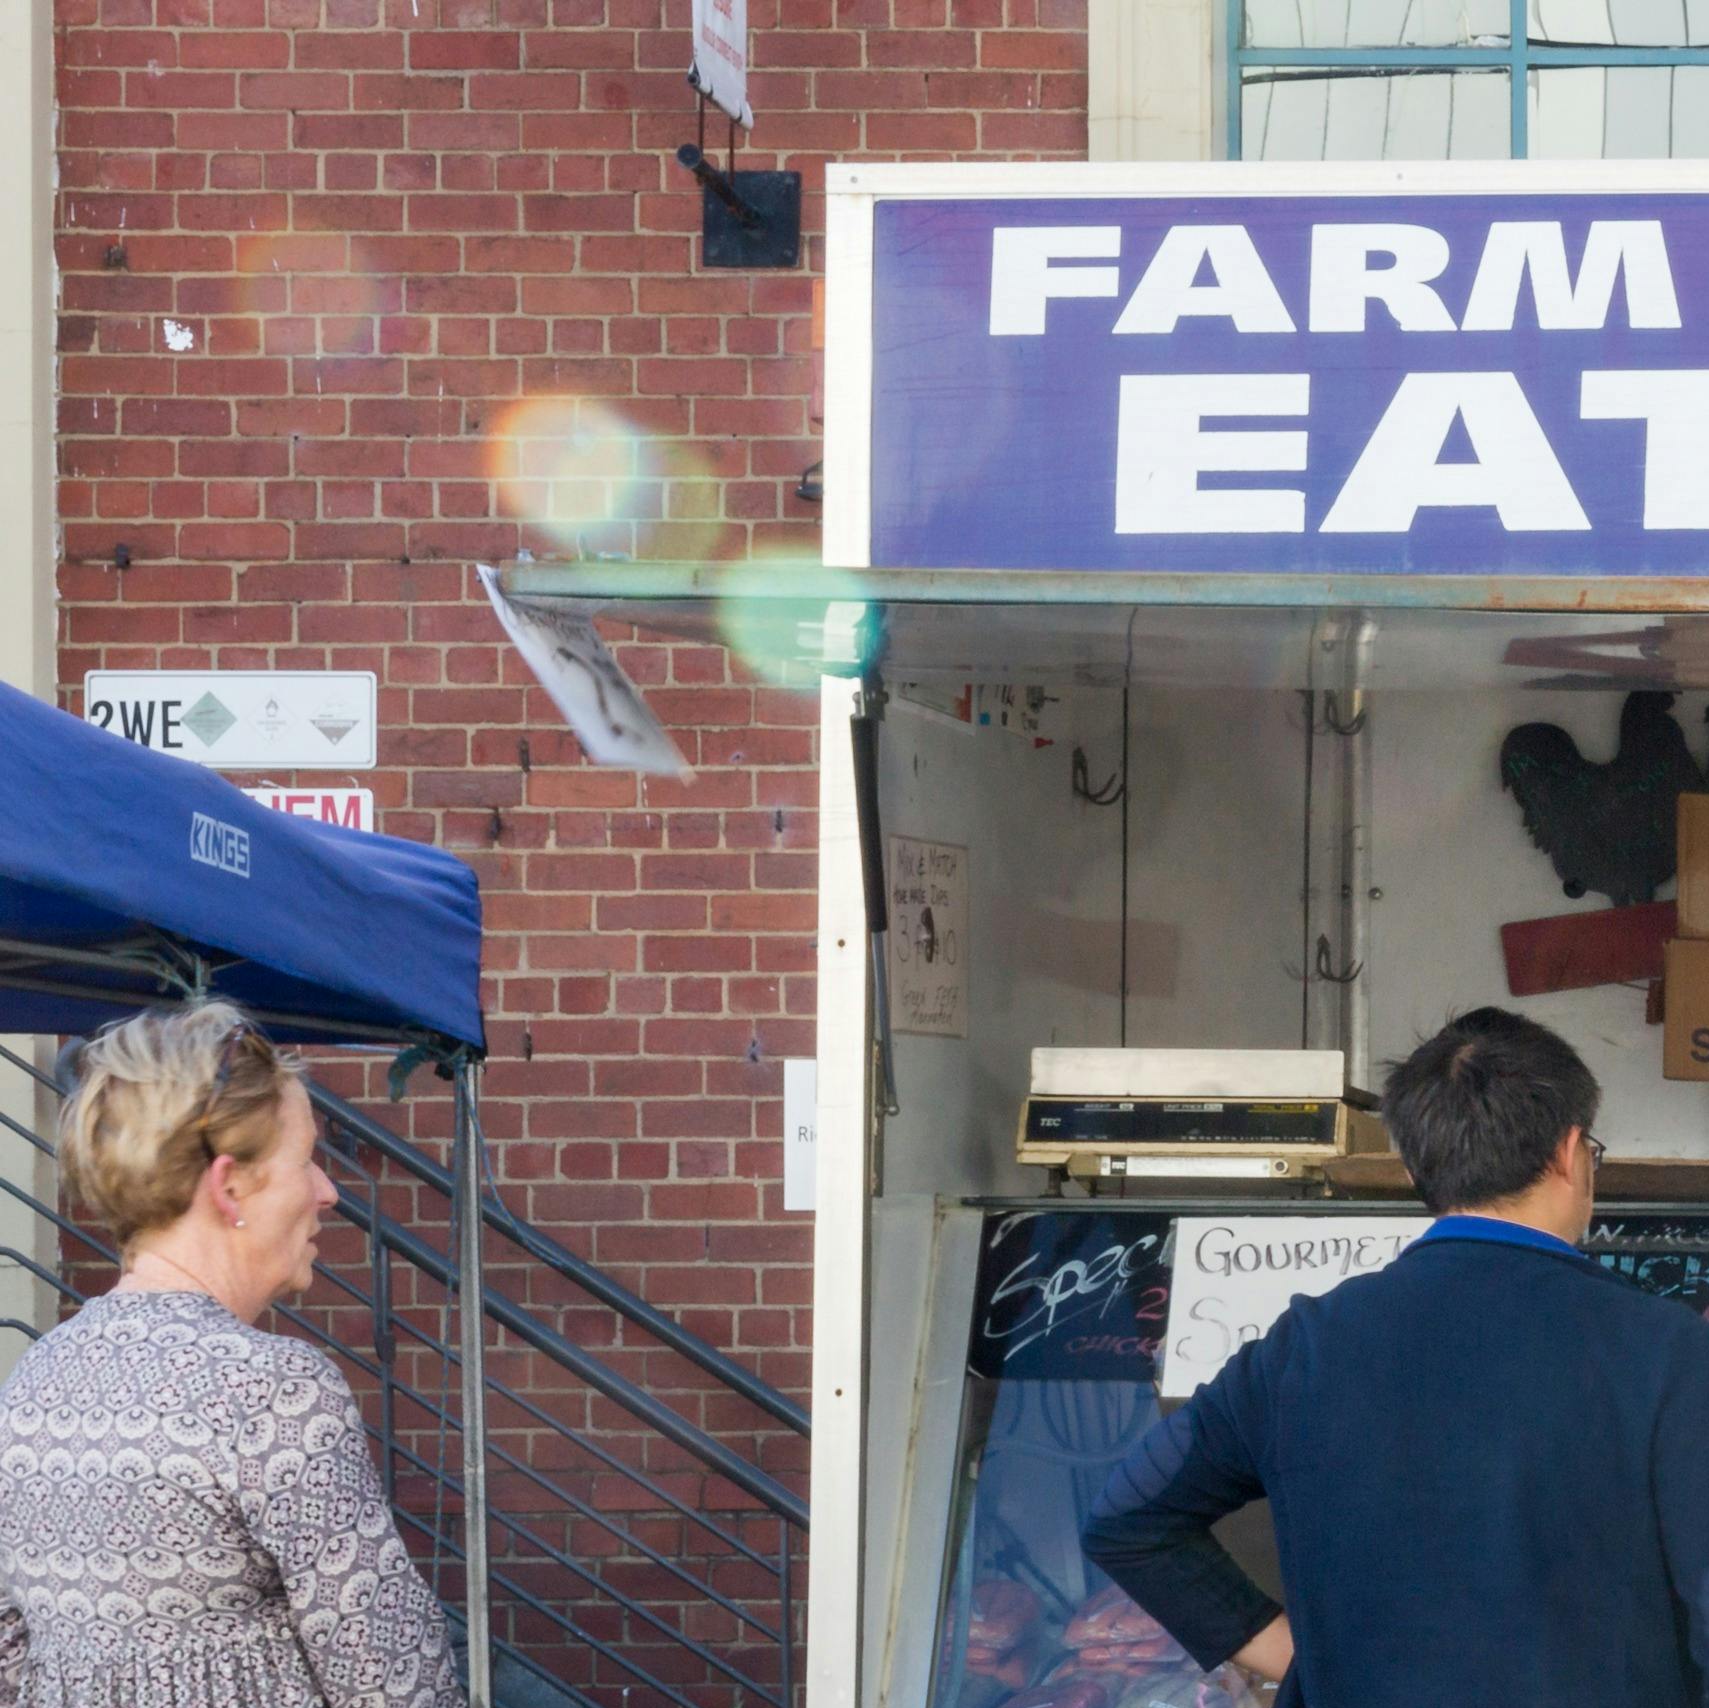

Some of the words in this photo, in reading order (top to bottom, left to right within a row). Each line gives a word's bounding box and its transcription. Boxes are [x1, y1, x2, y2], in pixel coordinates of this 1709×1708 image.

[989, 220, 1682, 336] FARM
[190, 812, 250, 878] KINGS
[1039, 1117, 1062, 1127] TEC
